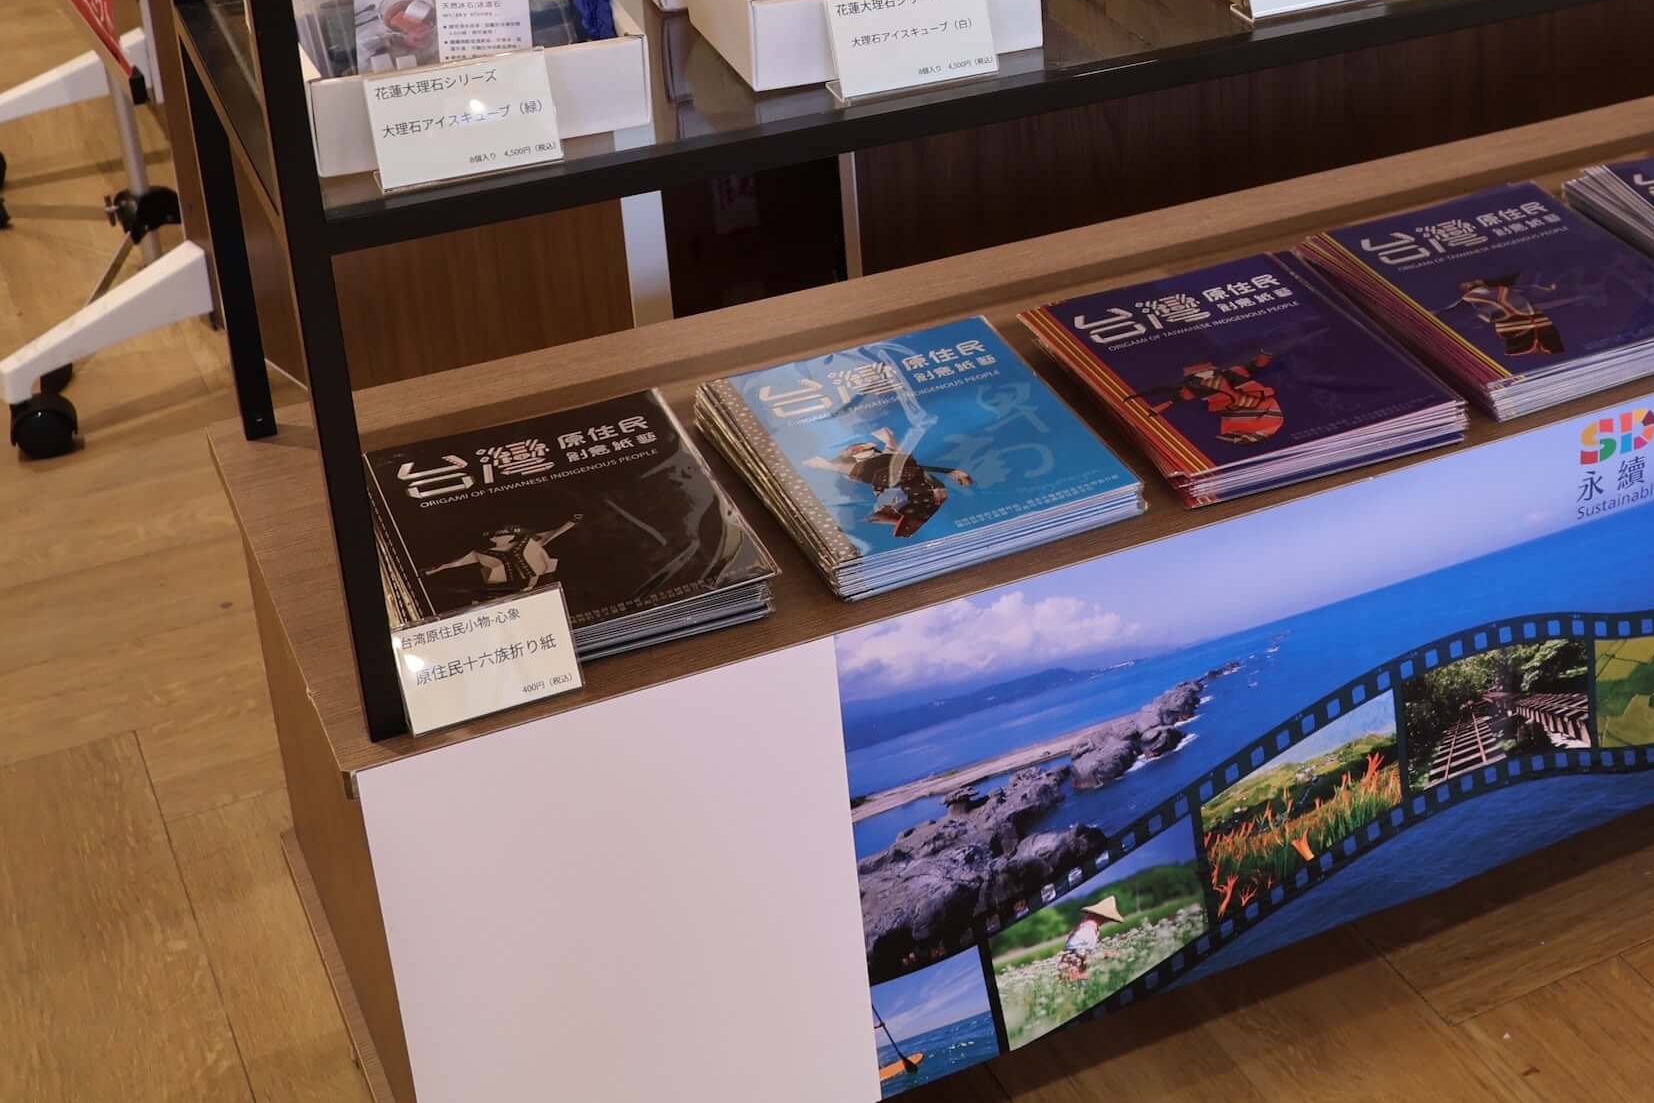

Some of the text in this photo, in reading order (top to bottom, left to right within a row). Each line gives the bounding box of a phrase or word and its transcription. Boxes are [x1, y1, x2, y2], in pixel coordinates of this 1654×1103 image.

[851, 17, 973, 49] 大理石アイスキューブ（白）
[375, 68, 498, 101] 花蓮大理石シリーズ
[382, 98, 544, 139] 大理石アイスキューブ（緑）
[1360, 219, 1489, 266] 台灣
[1074, 273, 1281, 344] 台灣 原住民
[1266, 300, 1300, 315] PEOPLE
[759, 339, 985, 418] 台灣 原住民
[397, 415, 650, 499] 台灣 原住民
[419, 448, 659, 508] ORIGAMI OF TAIWANESE INDIGENOUS PEOPLE
[400, 607, 521, 650] 台湾原住民小物-心象
[416, 633, 557, 686] 原住民十六族折り紙
